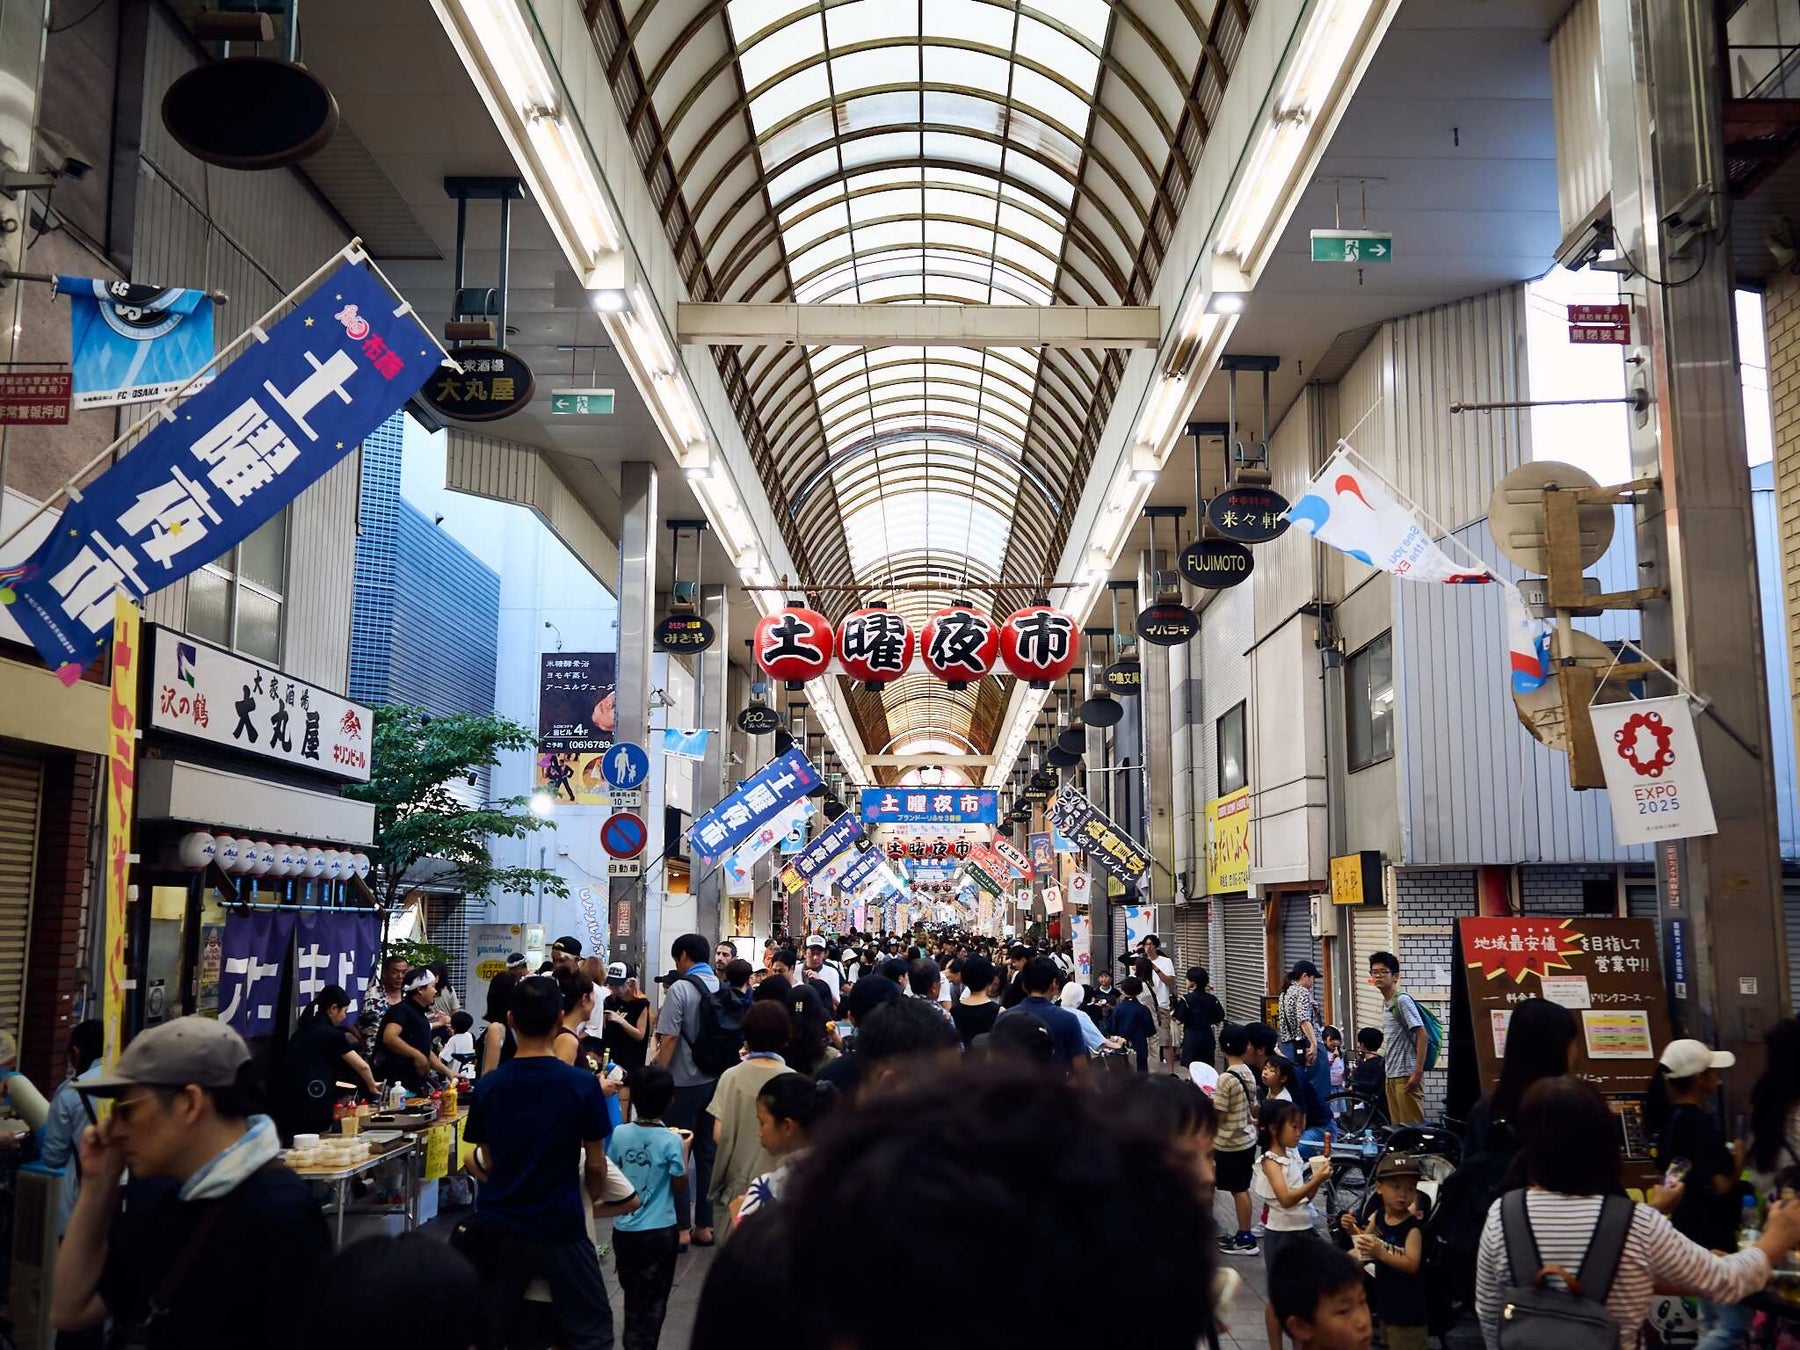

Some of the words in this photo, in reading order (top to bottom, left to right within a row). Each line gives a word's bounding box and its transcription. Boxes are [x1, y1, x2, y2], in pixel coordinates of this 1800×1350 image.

[132, 387, 159, 398] OSAKA
[436, 377, 515, 401] 大丸屋
[49, 349, 359, 634] 土曜夜市
[1221, 510, 1280, 529] 来々軒
[1187, 554, 1246, 571] FUJIMOTO
[763, 611, 1073, 672] 土曜夜市
[160, 684, 210, 728] 沢の鶴
[232, 684, 320, 761] 大丸屋
[333, 743, 366, 770] キリンビール
[1634, 784, 1678, 801] EXPO
[880, 794, 979, 813] 土曜夜市
[1638, 798, 1680, 815] 2025
[888, 840, 971, 856] 土曜夜市
[608, 864, 640, 874] 自動車
[1473, 935, 1558, 952] 地域最安値
[1580, 935, 1641, 952] を目指して
[1595, 956, 1650, 973] 営業中!!
